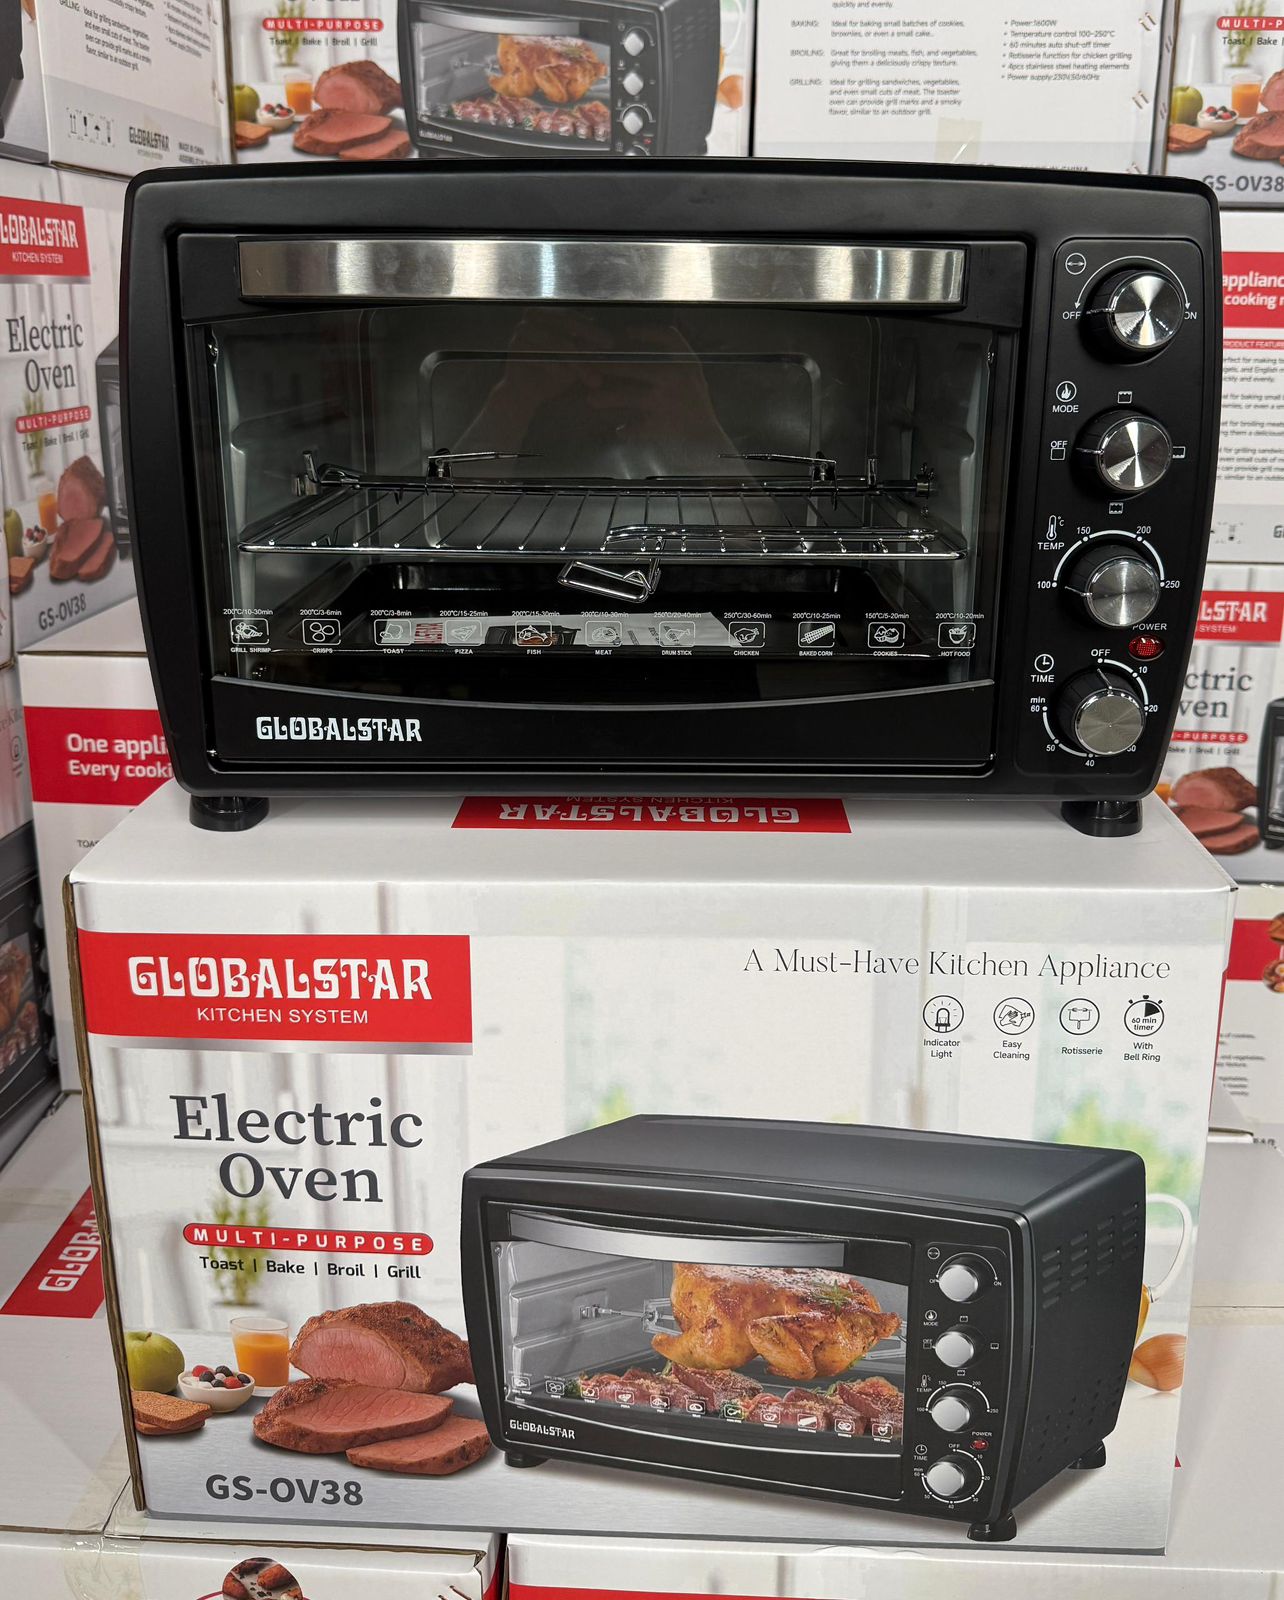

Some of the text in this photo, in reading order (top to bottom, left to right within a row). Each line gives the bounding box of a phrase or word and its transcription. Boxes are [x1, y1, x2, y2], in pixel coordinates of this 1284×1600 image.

[267, 20, 379, 30] MULTI-PURPOSE
[270, 38, 377, 46] Toast Bake Broil Grill
[1223, 37, 1278, 45] Toast Bake
[1110, 52, 1132, 60] grilling
[1224, 292, 1277, 310] cooking
[6, 313, 84, 353] Electric
[24, 359, 76, 393] Oven
[1052, 405, 1079, 413] MODE
[18, 409, 89, 431] MULTI-PURPOSE
[1136, 526, 1151, 534] 200
[1037, 581, 1050, 589] 100
[1165, 581, 1180, 589] 250
[38, 593, 87, 631] GS-OV38
[1201, 601, 1267, 622] LSTAR
[1184, 667, 1253, 691] ctric
[1179, 700, 1228, 717] ven
[256, 717, 422, 741] GLOBALSTAR
[67, 733, 168, 760] One appli
[68, 760, 120, 781] Every
[499, 804, 800, 823] GLOBALSTAR
[77, 840, 100, 848] TOA
[744, 949, 1171, 985] A Must-Have Kitchen Appliance
[128, 956, 432, 1000] GLOBALSTAR
[197, 1008, 368, 1024] KITCHEN SYSTEM
[923, 1039, 960, 1047] Indicator
[1002, 1040, 1022, 1049] Easy
[1062, 1047, 1103, 1055] Rotisserie
[1133, 1042, 1153, 1050] With
[930, 1050, 952, 1059] Light
[993, 1051, 1030, 1061] Cleaning
[1142, 1054, 1161, 1062] Ring
[169, 1093, 423, 1147] Electric
[219, 1152, 383, 1202] Oven
[193, 1228, 423, 1251] MULTI-PURPOSE
[38, 1210, 101, 1292] GLOBA
[200, 1256, 421, 1279] Toast Bake Broil Grill
[509, 1420, 575, 1439] GLOBALSTAR
[206, 1474, 363, 1506] GS-OV38
